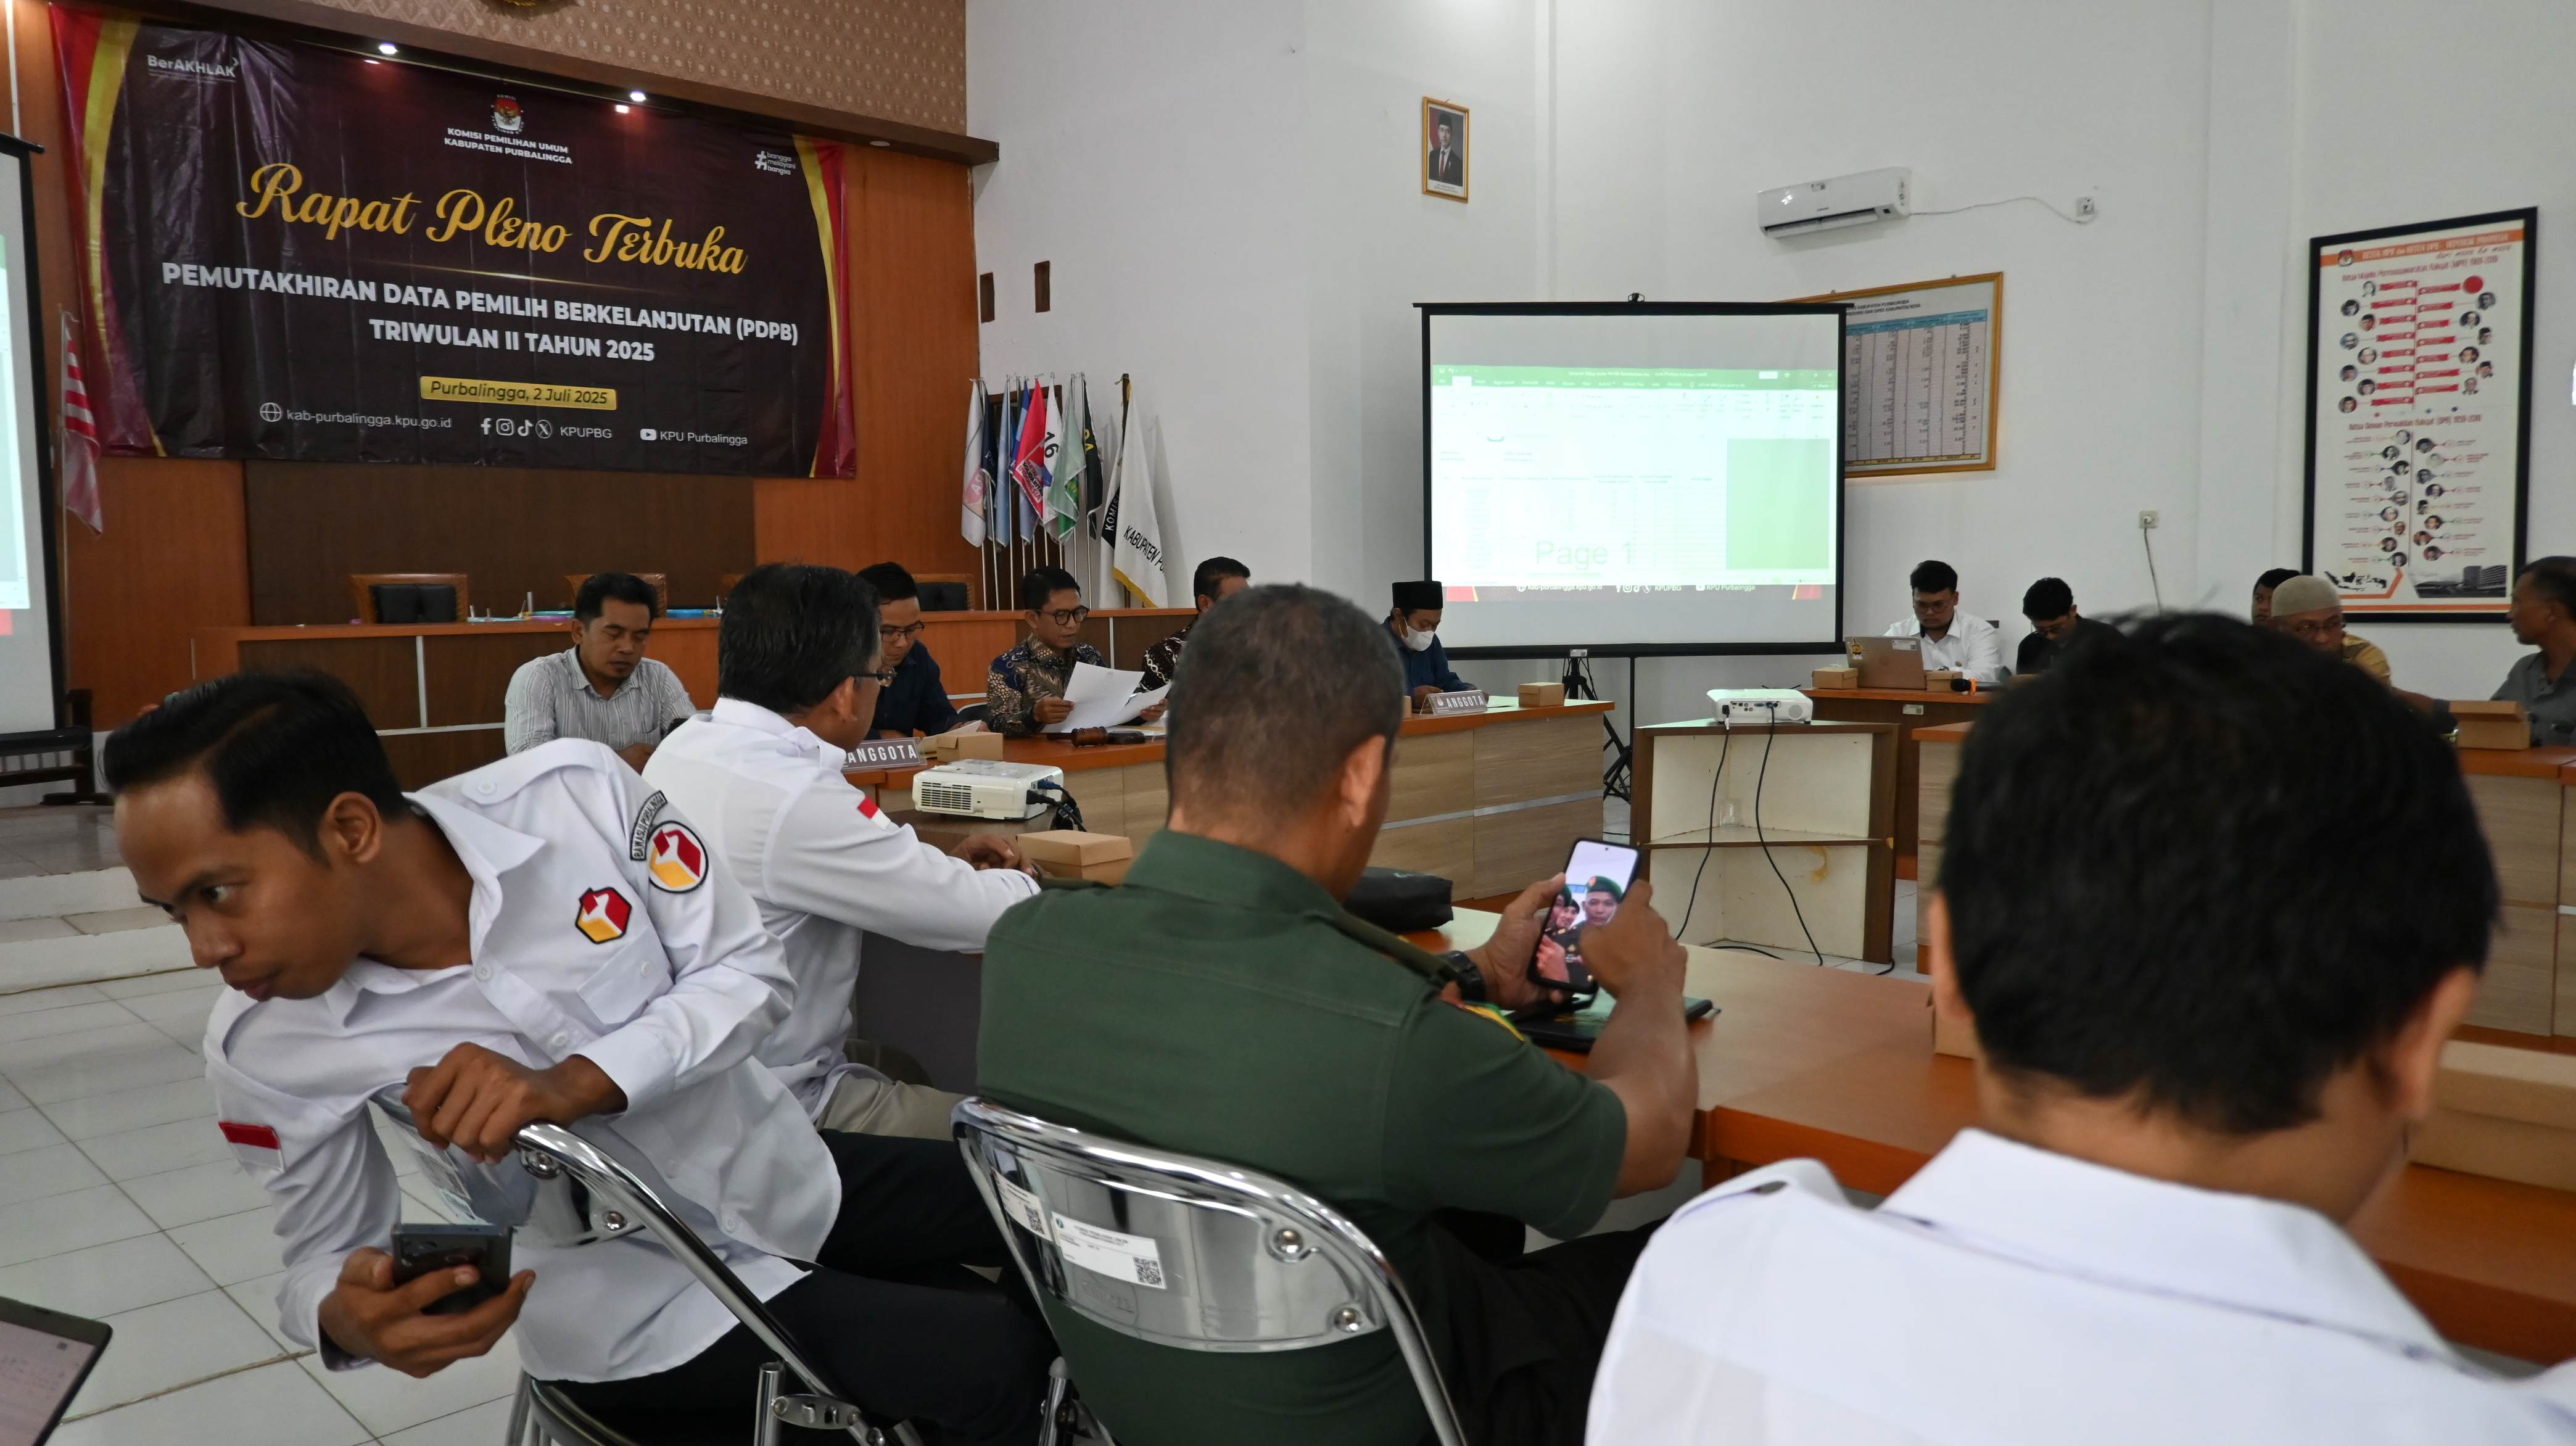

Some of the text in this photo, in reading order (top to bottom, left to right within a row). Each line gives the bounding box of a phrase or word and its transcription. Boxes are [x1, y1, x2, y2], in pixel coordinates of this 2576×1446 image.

[147, 54, 236, 78] BerAKHLAK
[444, 137, 571, 164] KABUPATEN PURBALINGGA
[447, 128, 568, 154] KOMISI PEMILIHAN UMUM
[767, 152, 791, 163] bangga
[767, 159, 796, 170] melayani
[767, 166, 791, 176] bangsa
[236, 163, 748, 275] Rapat Pleno Terbuka
[162, 262, 798, 345] PEMUTAKHIRAN DATA PEMILIH BERKELANJUTAN (PDPB)
[369, 319, 654, 362] TRIWULAN II TAHUN 2025
[431, 380, 608, 405] Purbalingga, 2 Juli 2025
[287, 409, 452, 428] kab-purbalingga.kpu.go.id
[561, 426, 748, 446] KPUPBG KPU Purbalingga
[1535, 540, 1631, 571] Page 1
[1446, 695, 1484, 709] ANGGOTA
[848, 744, 917, 763] ANGGOTA
